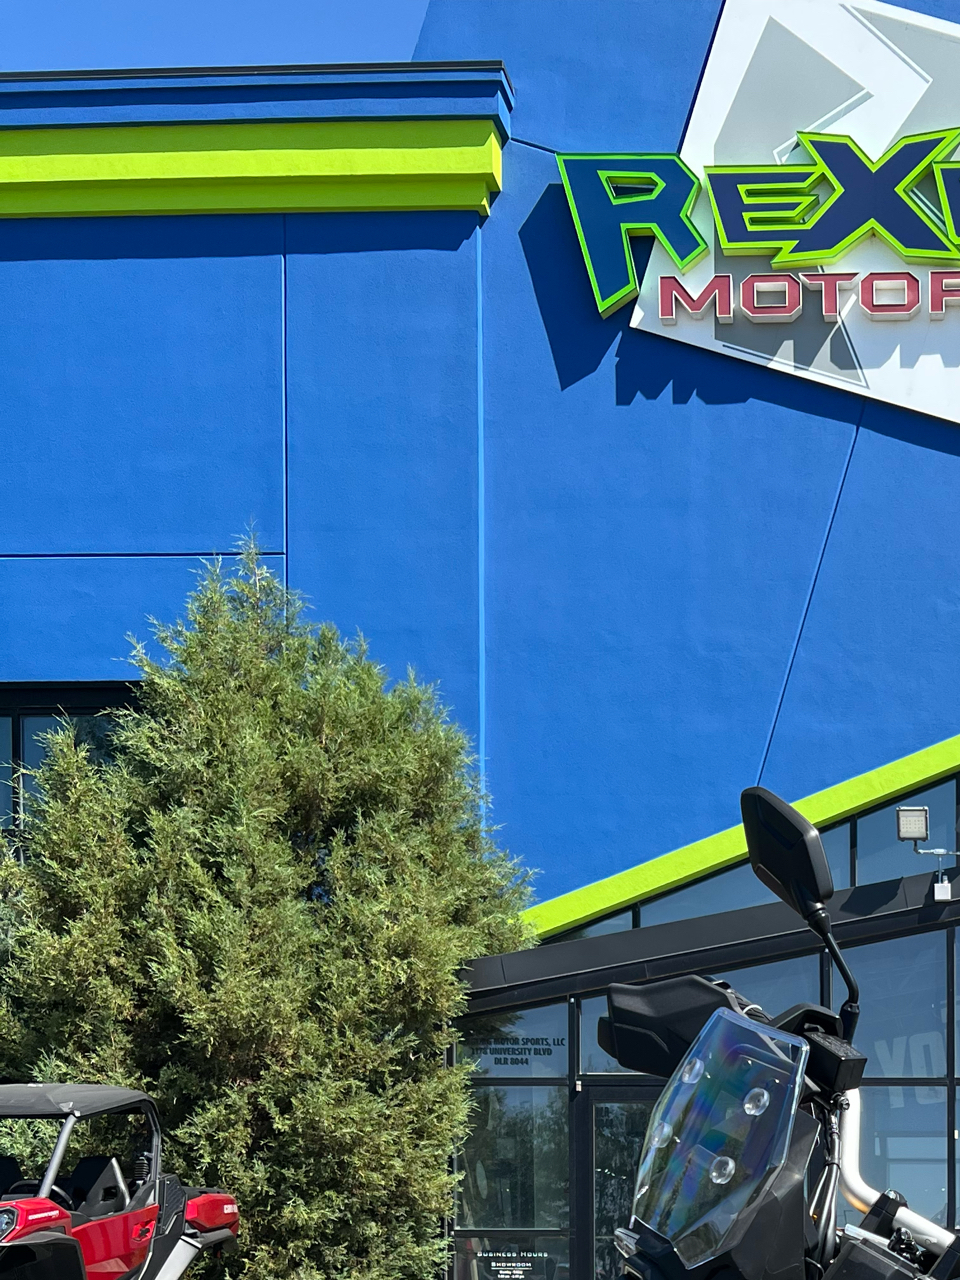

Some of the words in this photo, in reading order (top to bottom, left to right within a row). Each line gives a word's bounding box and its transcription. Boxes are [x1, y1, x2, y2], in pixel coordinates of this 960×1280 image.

[494, 1037, 520, 1046] MOTOR
[521, 1038, 551, 1047] SPORTS,
[553, 1038, 565, 1046] LLC
[489, 1047, 532, 1056] UNIVERSITY
[533, 1047, 553, 1056] BLVD
[494, 1057, 509, 1066] DLR
